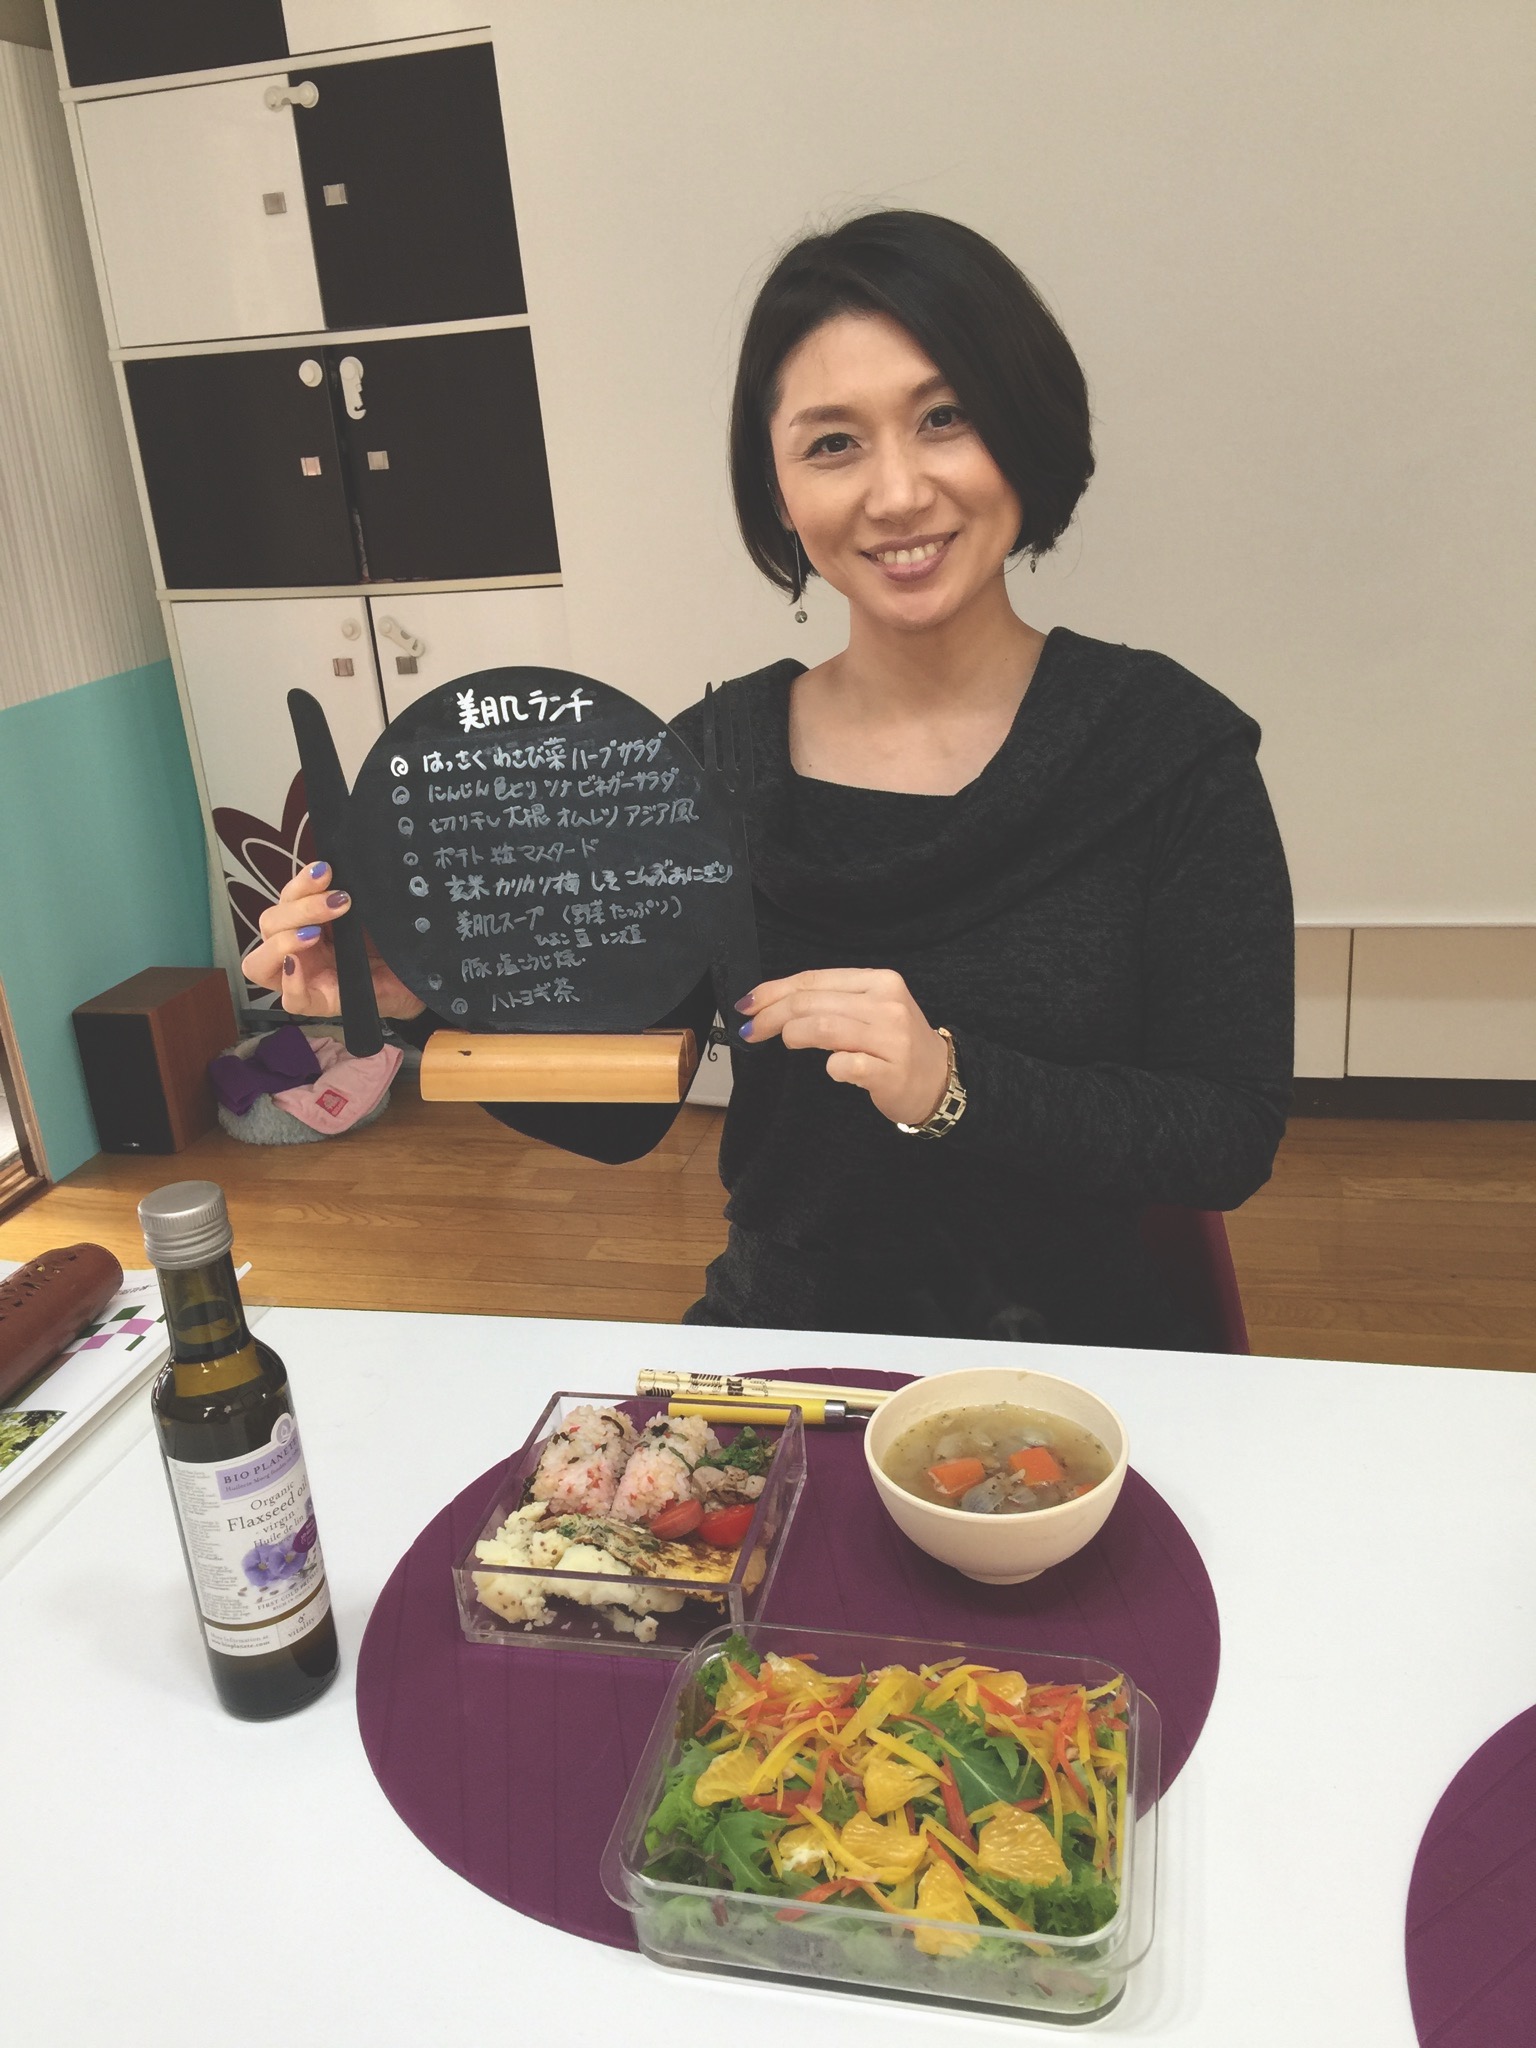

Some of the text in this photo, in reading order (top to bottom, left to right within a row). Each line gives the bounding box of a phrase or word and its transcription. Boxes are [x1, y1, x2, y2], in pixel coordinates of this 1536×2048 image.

[457, 688, 594, 732] 美肌ランチ
[422, 750, 487, 773] はっさく
[493, 737, 567, 771] わさび菜
[623, 797, 700, 827] アジア風
[224, 1471, 250, 1484] BIO
[227, 1491, 296, 1532] Flaxseed
[297, 1474, 308, 1497] oil
[250, 1480, 295, 1511] Organic
[253, 1530, 281, 1548] Huile
[283, 1523, 293, 1535] de
[293, 1514, 305, 1527] lin
[262, 1510, 296, 1535] virgin
[257, 1598, 279, 1611] FIRST
[287, 1615, 316, 1638] vitality
